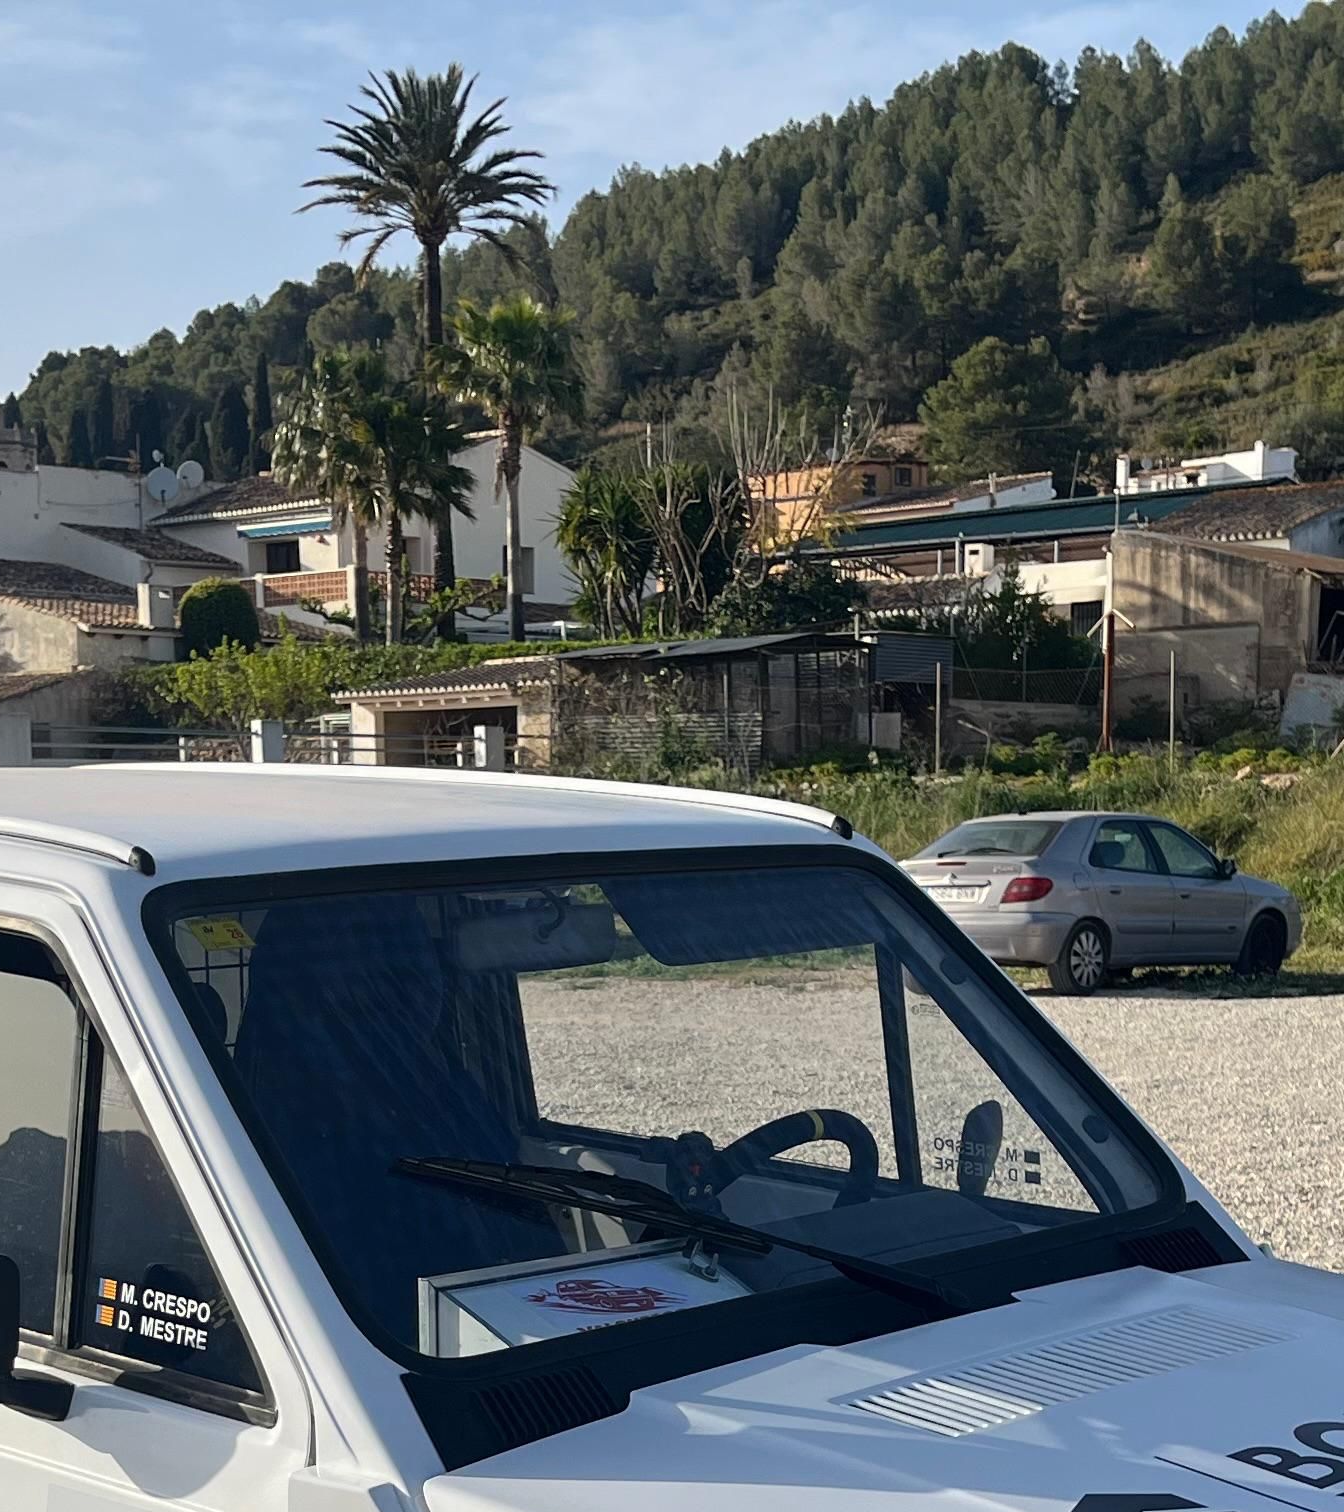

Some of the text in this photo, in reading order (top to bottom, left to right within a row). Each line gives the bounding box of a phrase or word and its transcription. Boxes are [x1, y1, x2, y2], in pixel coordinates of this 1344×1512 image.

[120, 1282, 211, 1323] M. CRESPO
[117, 1310, 208, 1351] D. MESTRE
